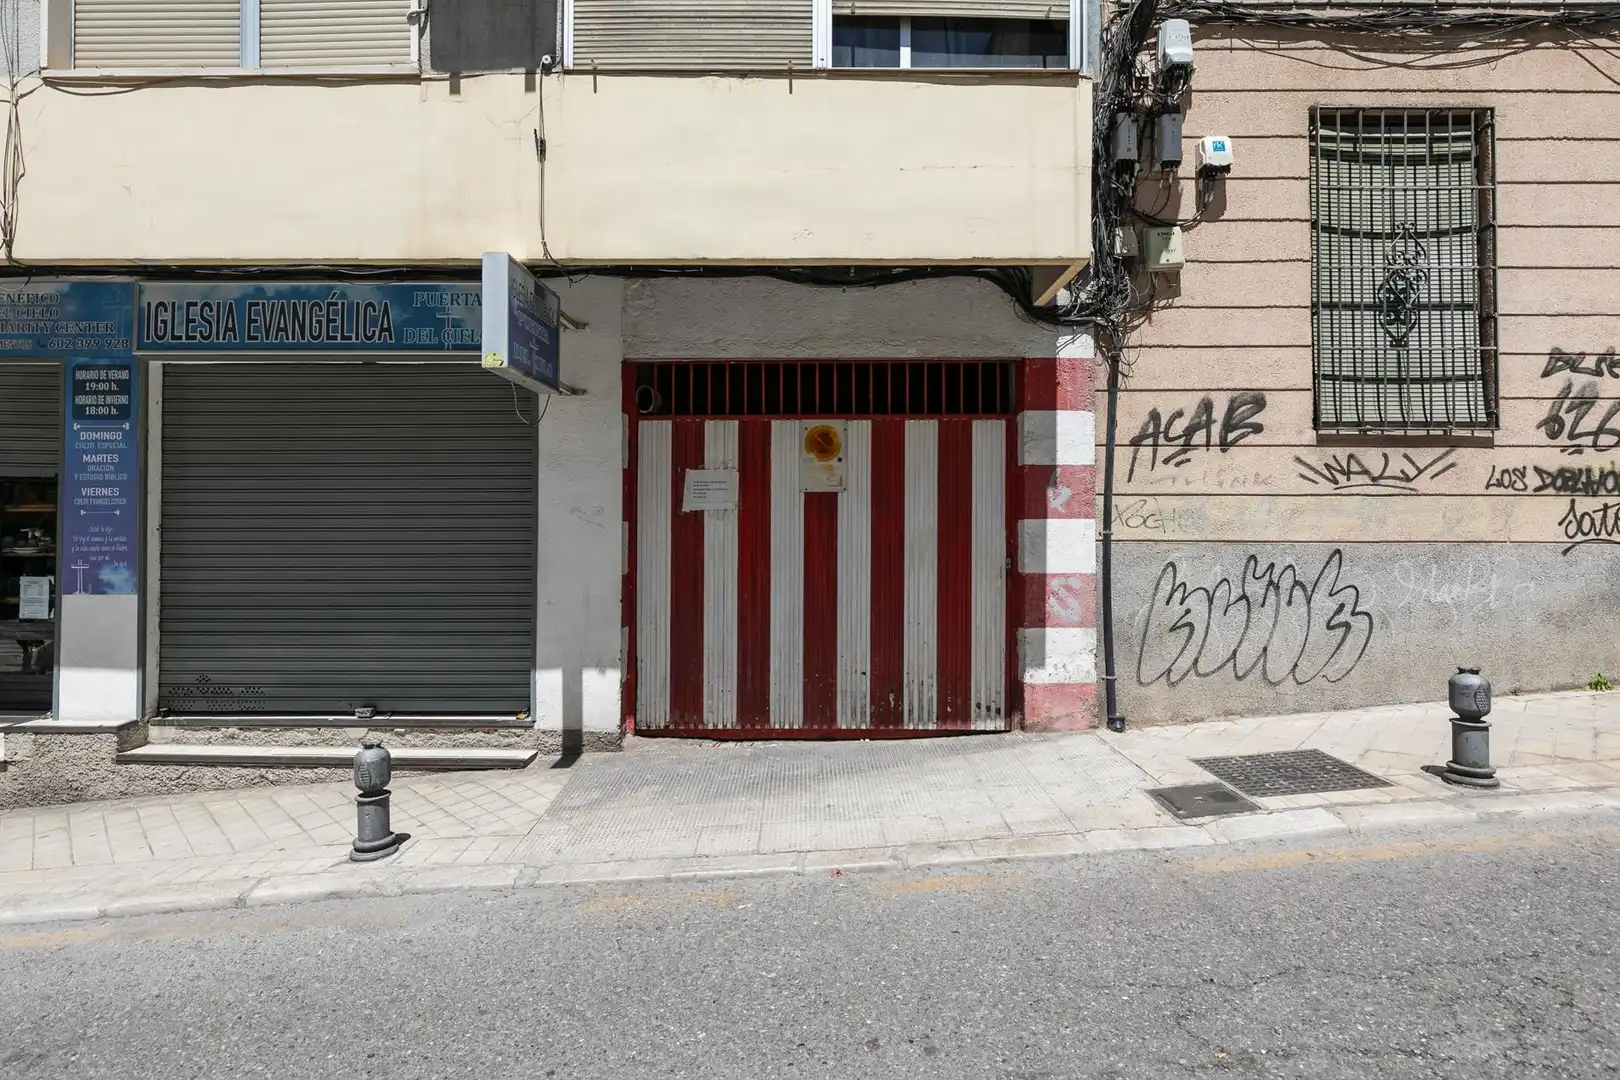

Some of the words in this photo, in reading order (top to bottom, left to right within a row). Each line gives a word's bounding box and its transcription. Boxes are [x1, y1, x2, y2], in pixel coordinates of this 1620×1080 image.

[413, 291, 483, 307] PUERTA
[16, 306, 60, 319] CIELO
[144, 300, 239, 343] IGLESIA
[245, 291, 395, 343] EVANGÉLICA
[55, 321, 116, 333] CENTER
[403, 328, 438, 344] DEL
[441, 328, 483, 344] CIEL
[48, 338, 72, 349] 602
[76, 338, 100, 349] 399
[104, 338, 129, 349] 928
[75, 370, 98, 380] HORARIO
[99, 370, 107, 380] DE
[108, 370, 130, 380] VERANO
[85, 382, 109, 391] 19:00
[111, 382, 119, 391] h.
[75, 395, 97, 405] HORARIO
[98, 395, 105, 405] DE
[105, 395, 129, 405] INVIERNO
[85, 406, 109, 415] 18:00
[111, 406, 119, 415] h.
[80, 432, 122, 440] DOMINGO
[1127, 392, 1267, 483] ACAB
[83, 454, 119, 463] MARTES
[1485, 465, 1528, 492] LOS
[81, 488, 120, 496] VIERNES
